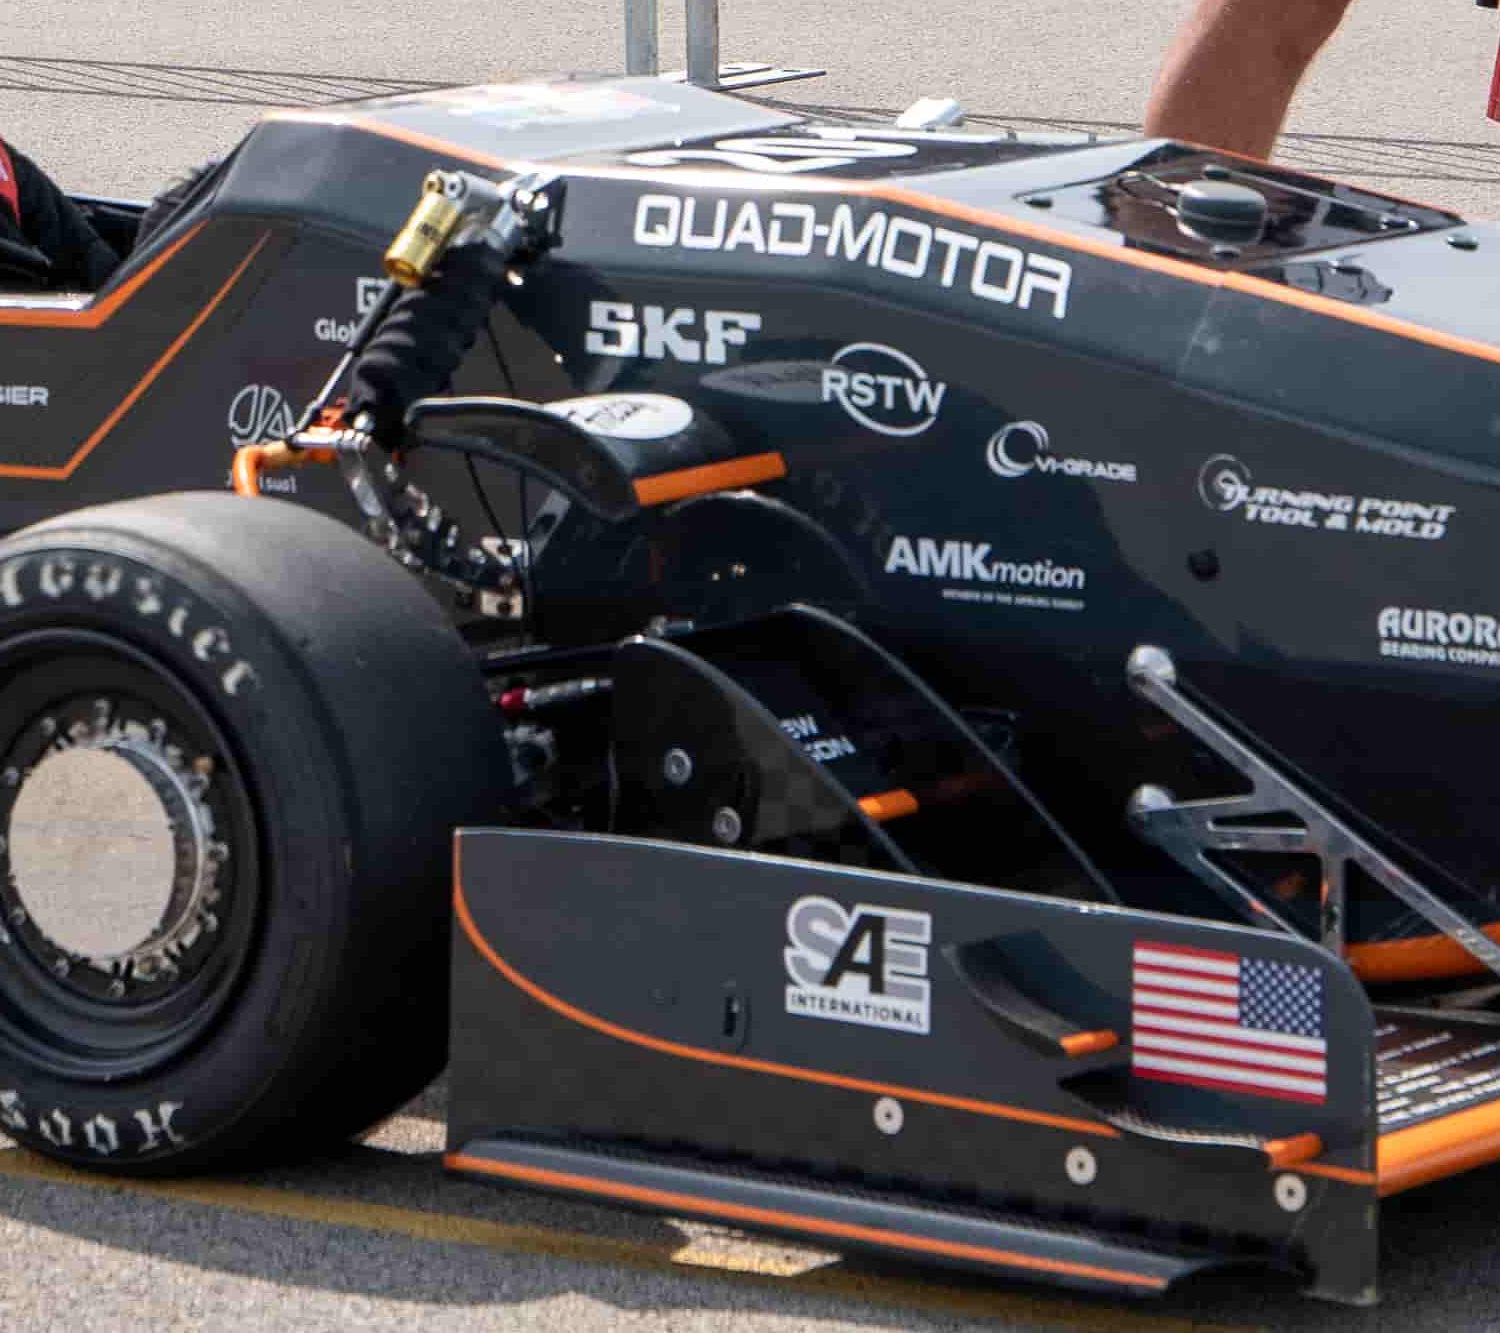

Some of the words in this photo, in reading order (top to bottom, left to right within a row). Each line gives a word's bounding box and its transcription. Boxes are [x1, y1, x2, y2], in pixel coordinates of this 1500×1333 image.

[634, 194, 1073, 319] QUAD-MOTOR
[585, 300, 760, 364] SKF
[822, 369, 947, 415] RSTW
[1034, 455, 1137, 483] VI-GRADE
[1245, 504, 1319, 528] TOOL
[1354, 516, 1446, 540] MOLD
[1358, 497, 1456, 522] POINT
[1380, 640, 1446, 663] BEARING
[784, 895, 932, 1008] SAE
[790, 990, 925, 1029] INTERNATIONAL
